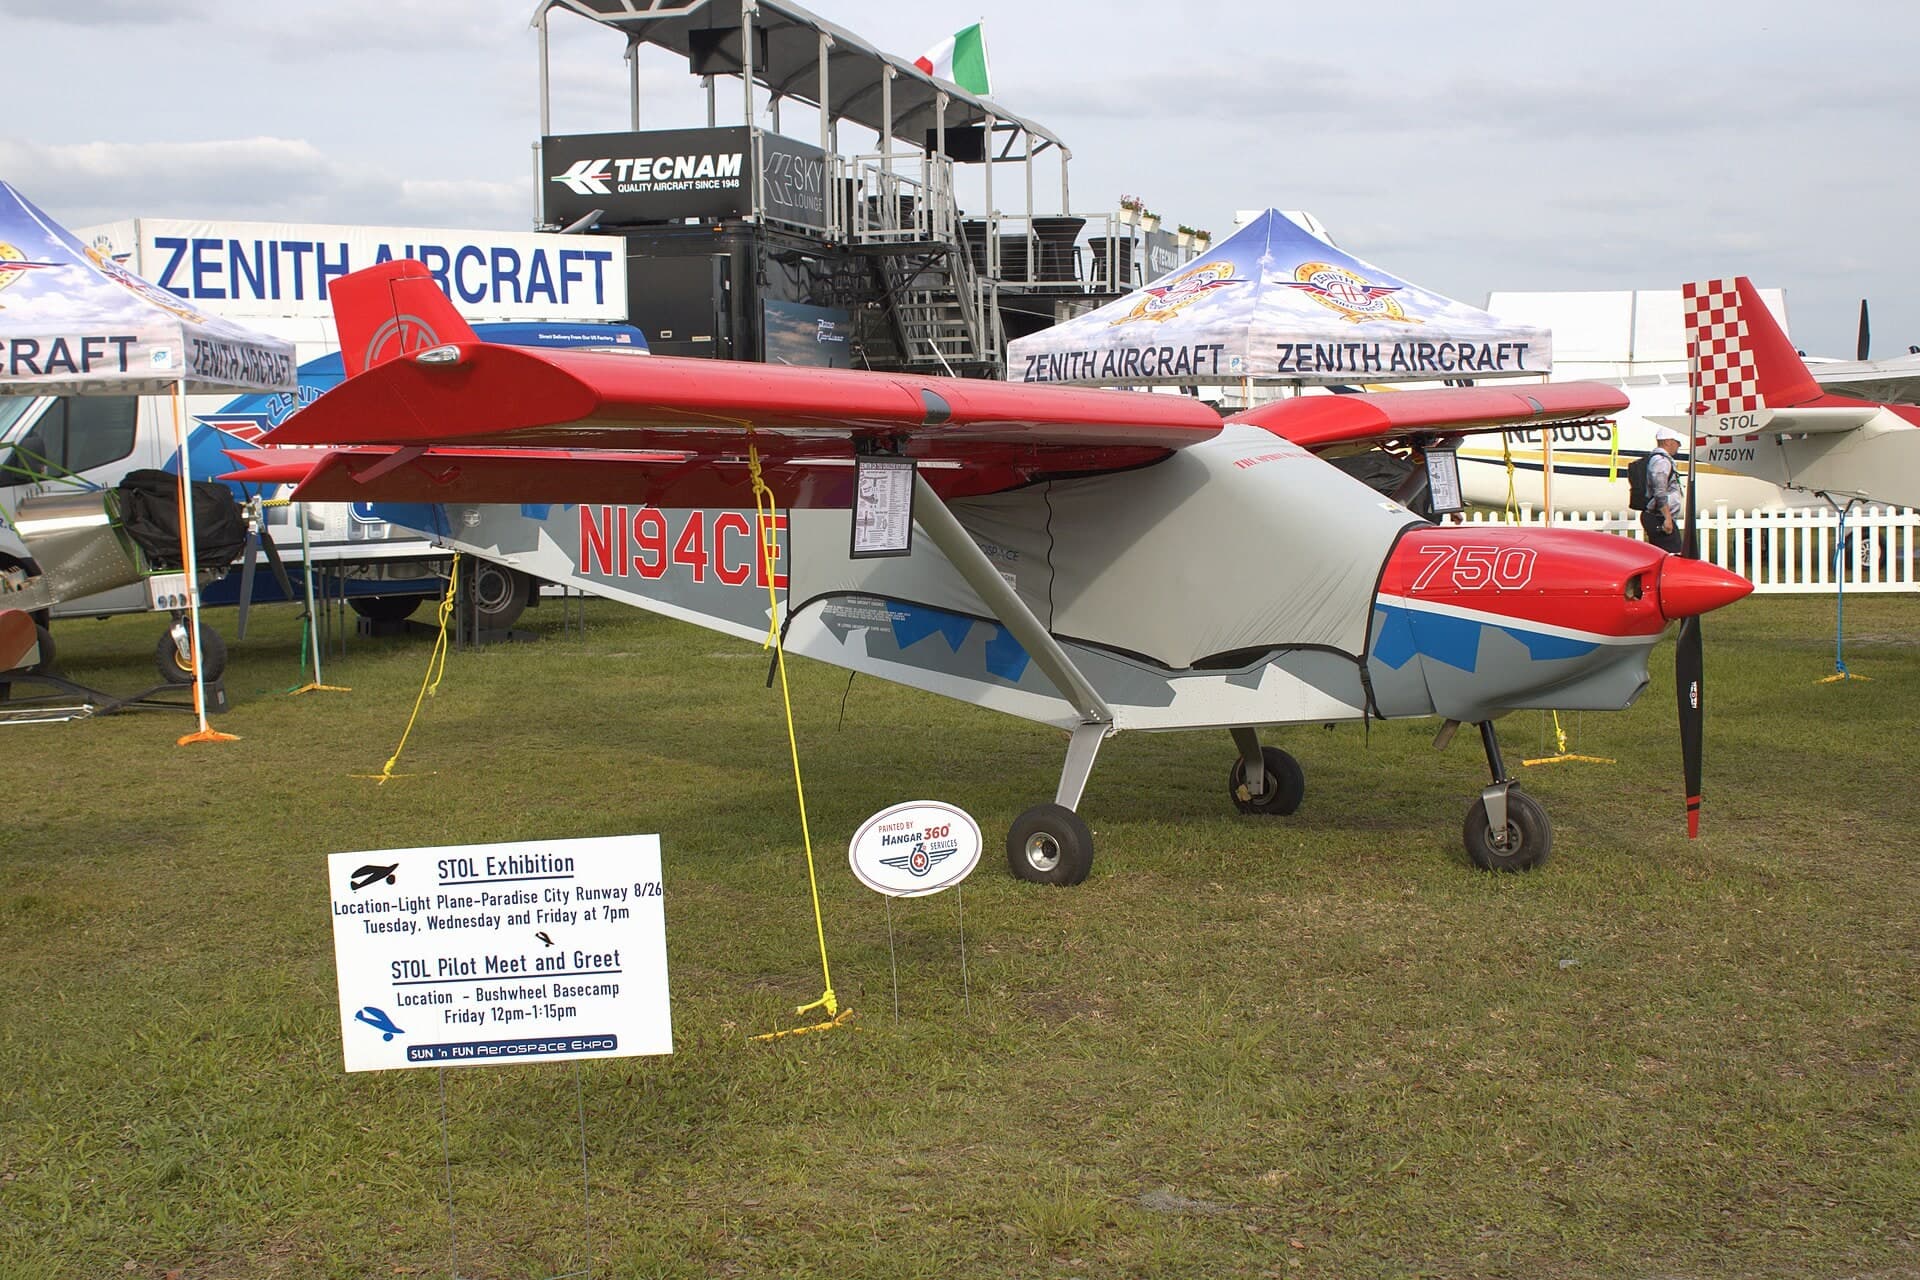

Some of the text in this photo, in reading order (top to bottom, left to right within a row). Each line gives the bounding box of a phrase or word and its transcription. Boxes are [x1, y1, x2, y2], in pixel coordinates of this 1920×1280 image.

[614, 153, 743, 182] TECNAM
[793, 155, 824, 193] SKY
[617, 179, 740, 193] QUALITY AIRCRAFT SINCE 1948
[794, 193, 824, 212] LOUNGE
[154, 236, 612, 305] ZENITH RCRAFT
[193, 339, 292, 385] ZENITH AIRCRAFT
[1024, 344, 1225, 383] ZENITH AIRCRAFT
[1276, 343, 1529, 373] ZENITH AIRCRAFT
[1719, 414, 1759, 431] STOL
[1708, 448, 1755, 462] N750YN
[579, 503, 788, 590] N194CE
[1410, 544, 1538, 590] 750
[878, 821, 914, 833] PAINTED BY
[930, 838, 958, 850] SERVICES
[437, 853, 575, 879] STOL Exhibition
[334, 881, 663, 916] Location-Light Plane-Paradise City Runway 8/26
[427, 912, 501, 932] Wednesday
[507, 910, 531, 926] and
[537, 907, 578, 926] Friday
[584, 907, 597, 921] at
[602, 905, 630, 922] 7pm
[391, 949, 621, 979] STOL Pilot Meet and Greet
[397, 990, 453, 1007] Location
[476, 984, 547, 1002] Bushwheel
[554, 982, 620, 1000] Basecamp
[444, 1004, 577, 1027] Friday 12pm-1:15pm
[411, 1049, 433, 1060] SUN
[452, 1045, 474, 1057] FUN
